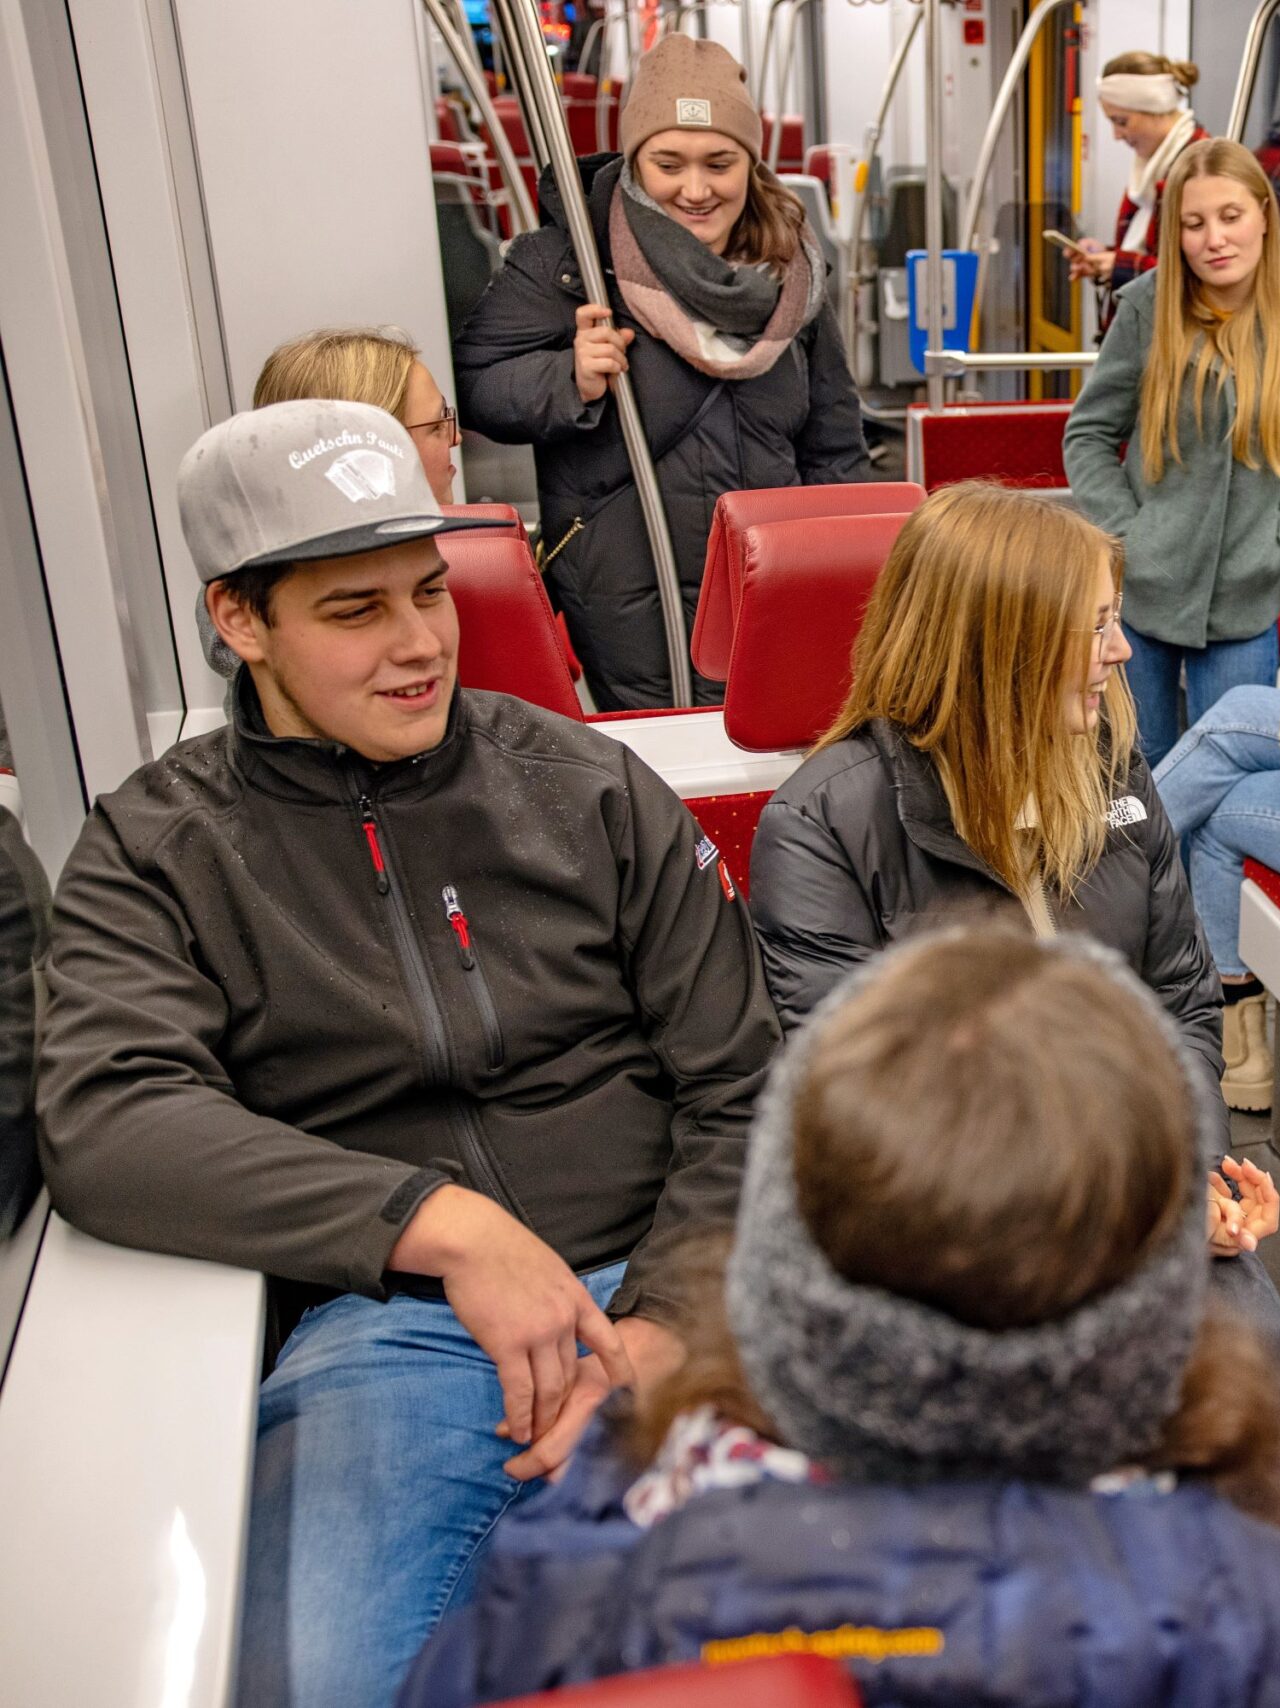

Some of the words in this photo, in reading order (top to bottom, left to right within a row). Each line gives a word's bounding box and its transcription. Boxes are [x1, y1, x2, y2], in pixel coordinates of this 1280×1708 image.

[288, 429, 362, 469] Quetschn
[1109, 798, 1129, 811] THE
[1104, 805, 1131, 821] ORTH
[1110, 814, 1135, 830] FACE
